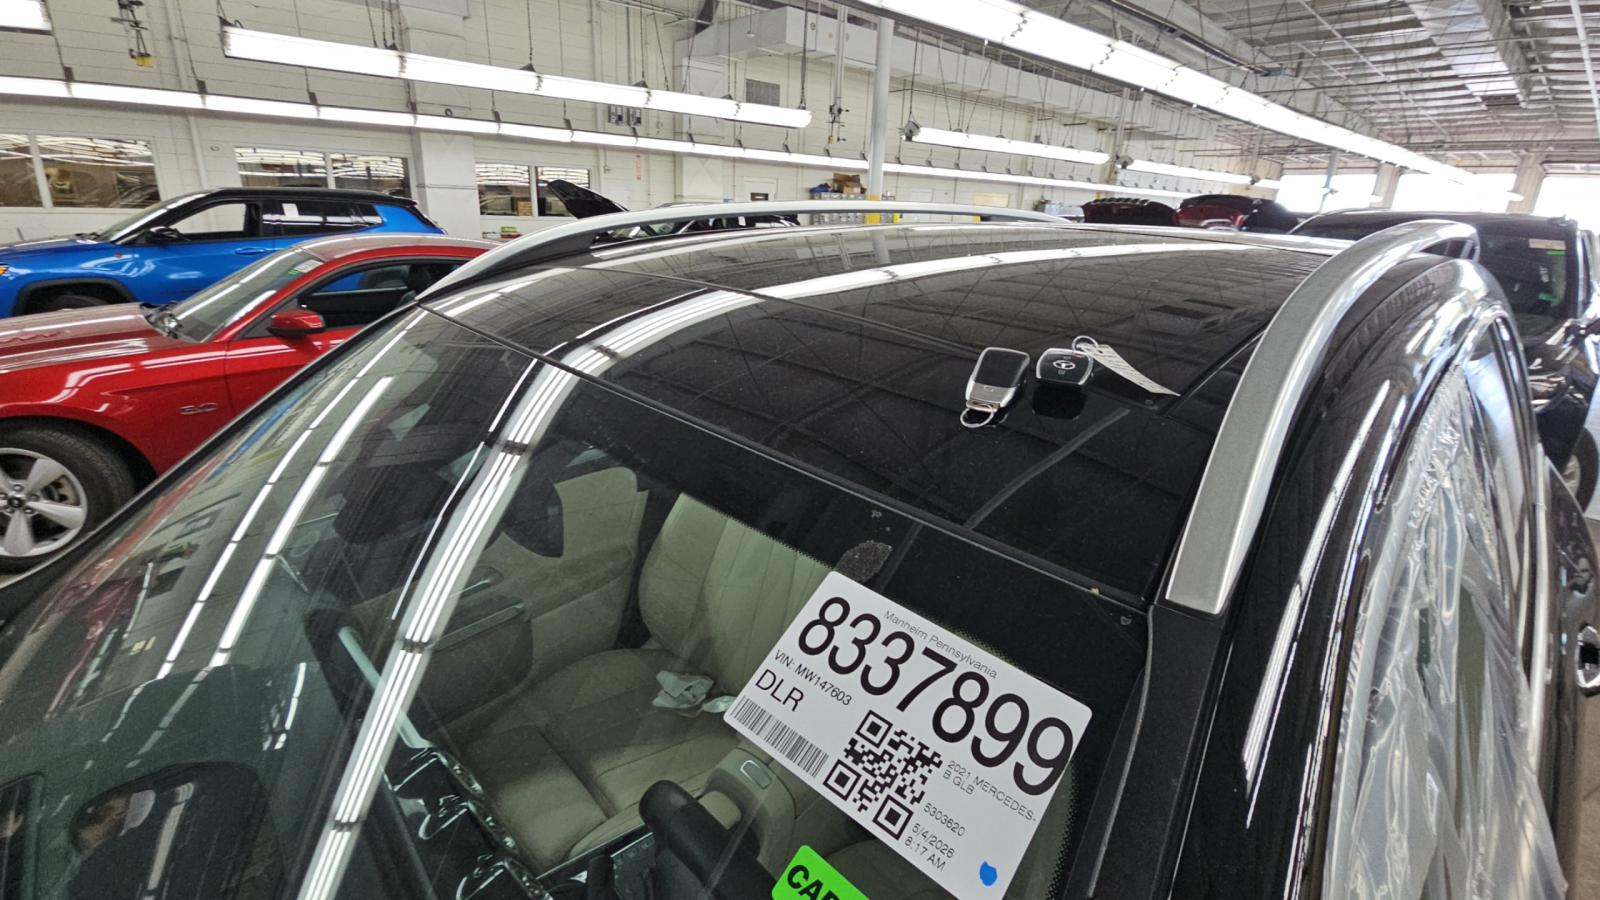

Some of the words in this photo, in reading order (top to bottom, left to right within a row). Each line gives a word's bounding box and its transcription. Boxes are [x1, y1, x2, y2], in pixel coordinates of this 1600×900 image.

[883, 610, 927, 640] Manheim
[928, 635, 998, 679] Pennsylvania
[755, 668, 804, 712] DLR
[774, 649, 796, 670] VIN:
[794, 663, 853, 706] MW147603
[798, 596, 1074, 796] 8337899
[942, 769, 953, 780] B
[952, 775, 976, 796] GLB
[947, 760, 972, 780] 2021
[923, 802, 967, 837] 5303620
[904, 836, 928, 856] 8:17
[926, 853, 947, 873] AM
[911, 822, 956, 859] 5/4/2026
